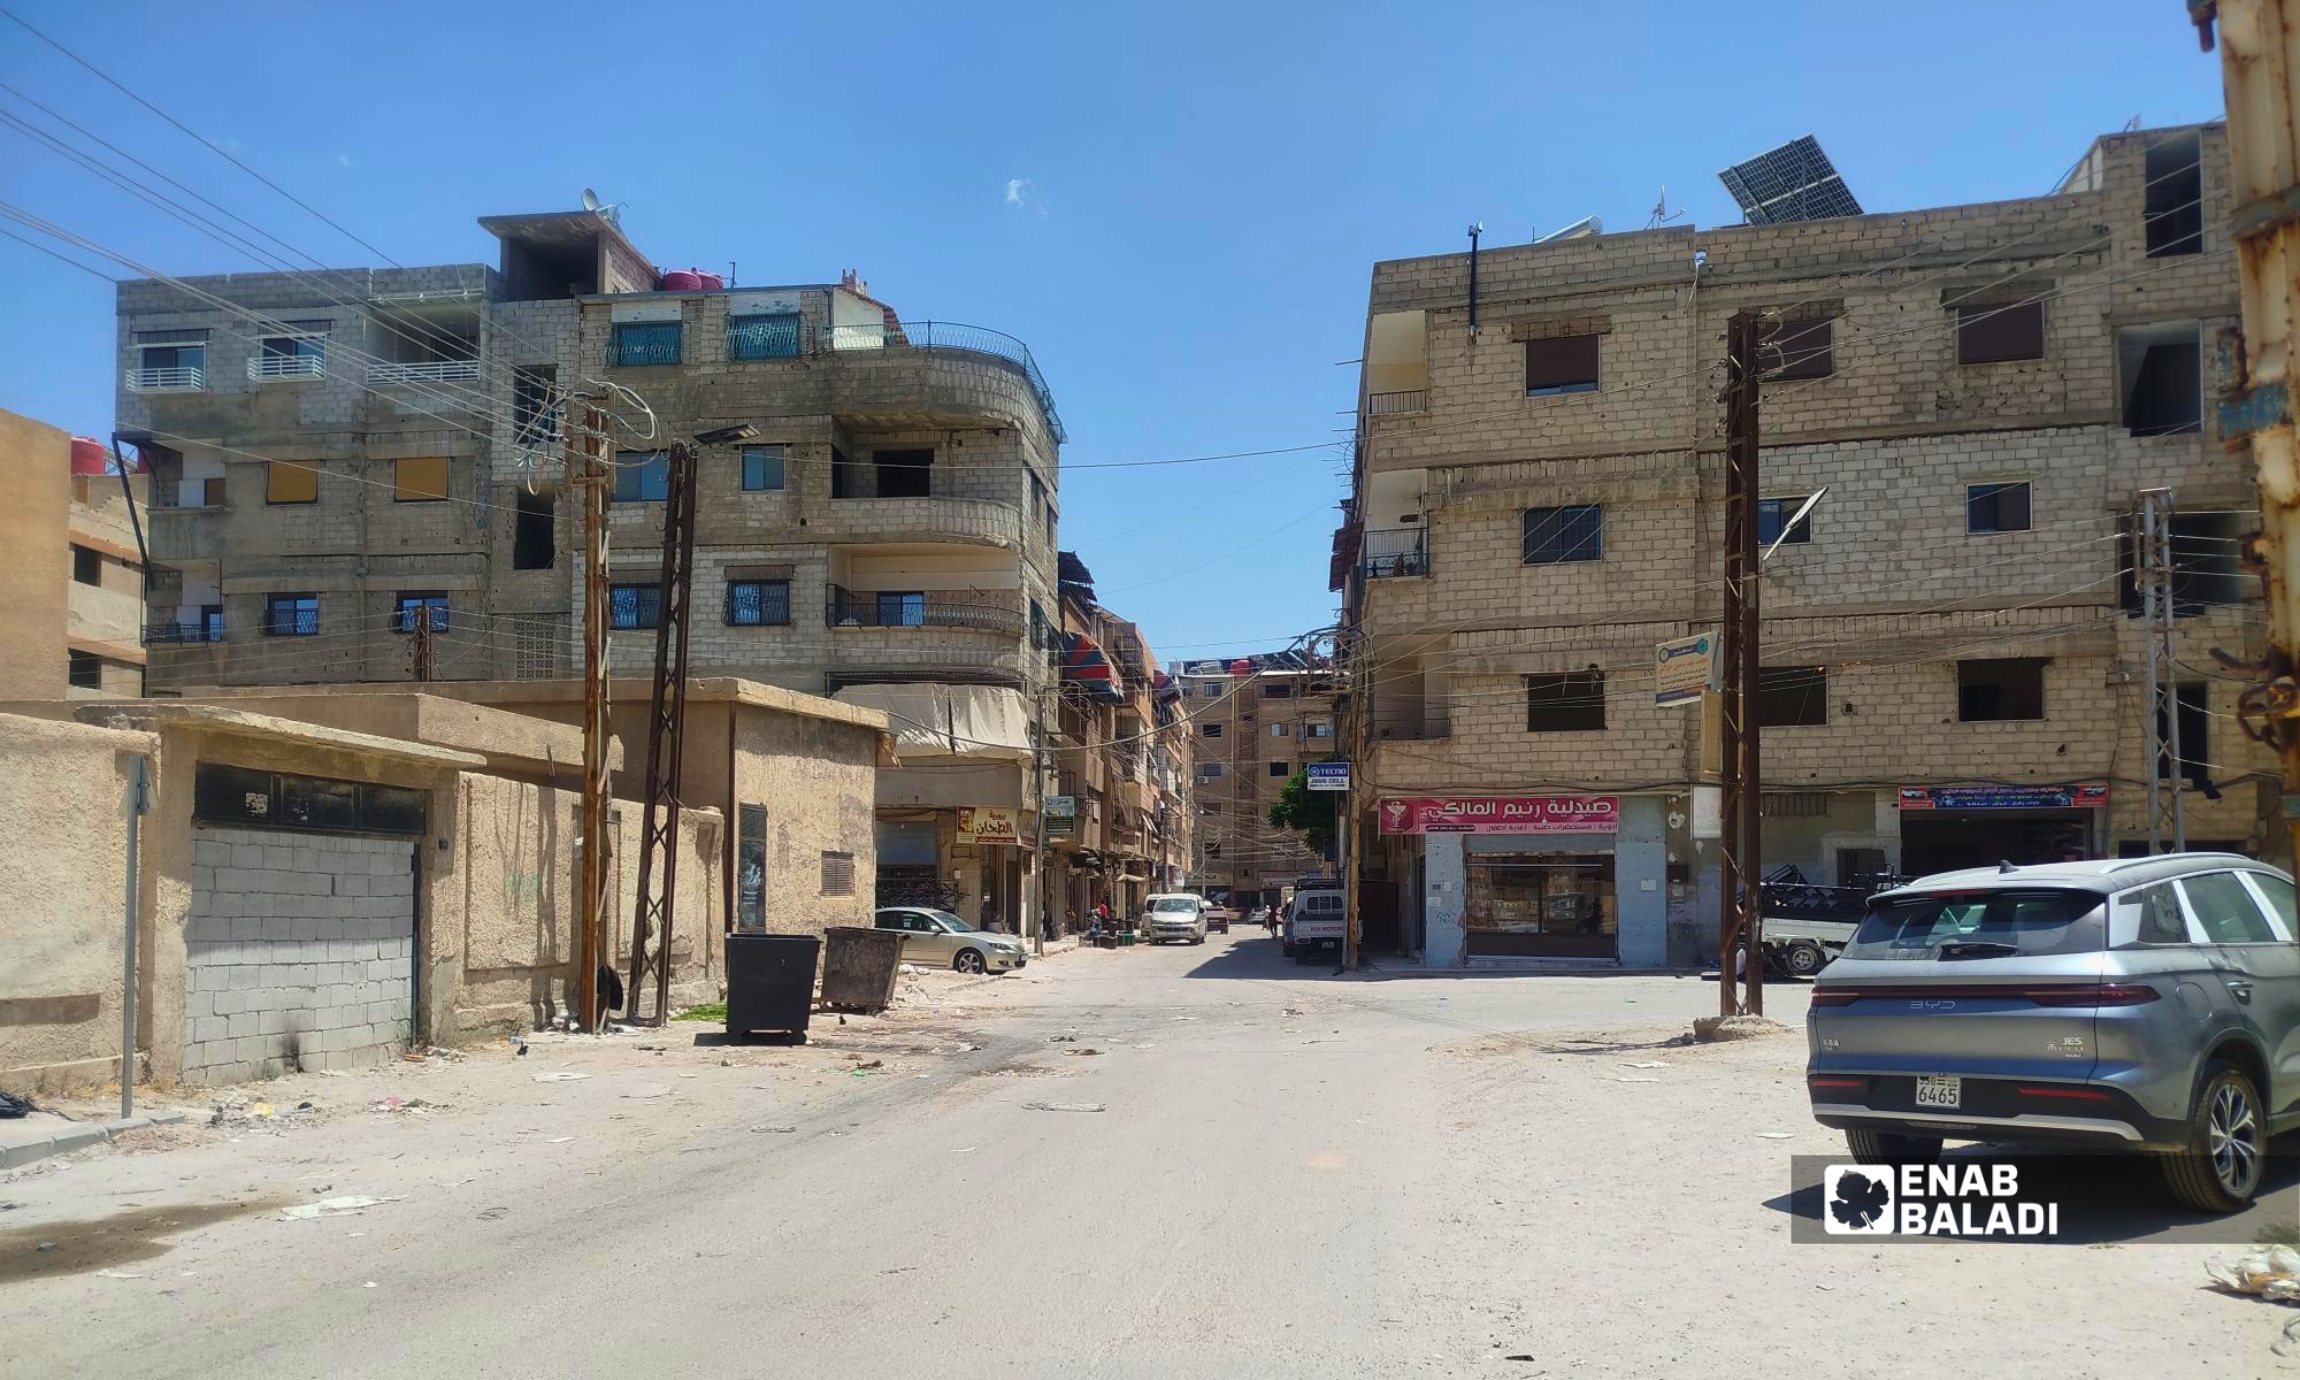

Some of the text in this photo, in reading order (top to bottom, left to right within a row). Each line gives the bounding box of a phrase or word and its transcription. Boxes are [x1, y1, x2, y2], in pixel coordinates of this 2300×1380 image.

[1427, 799, 1611, 821] صيدلية رنيم المالكي
[976, 820, 1013, 835] الطحان
[1909, 1000, 1957, 1010] BYD
[1918, 1086, 1957, 1105] 6465
